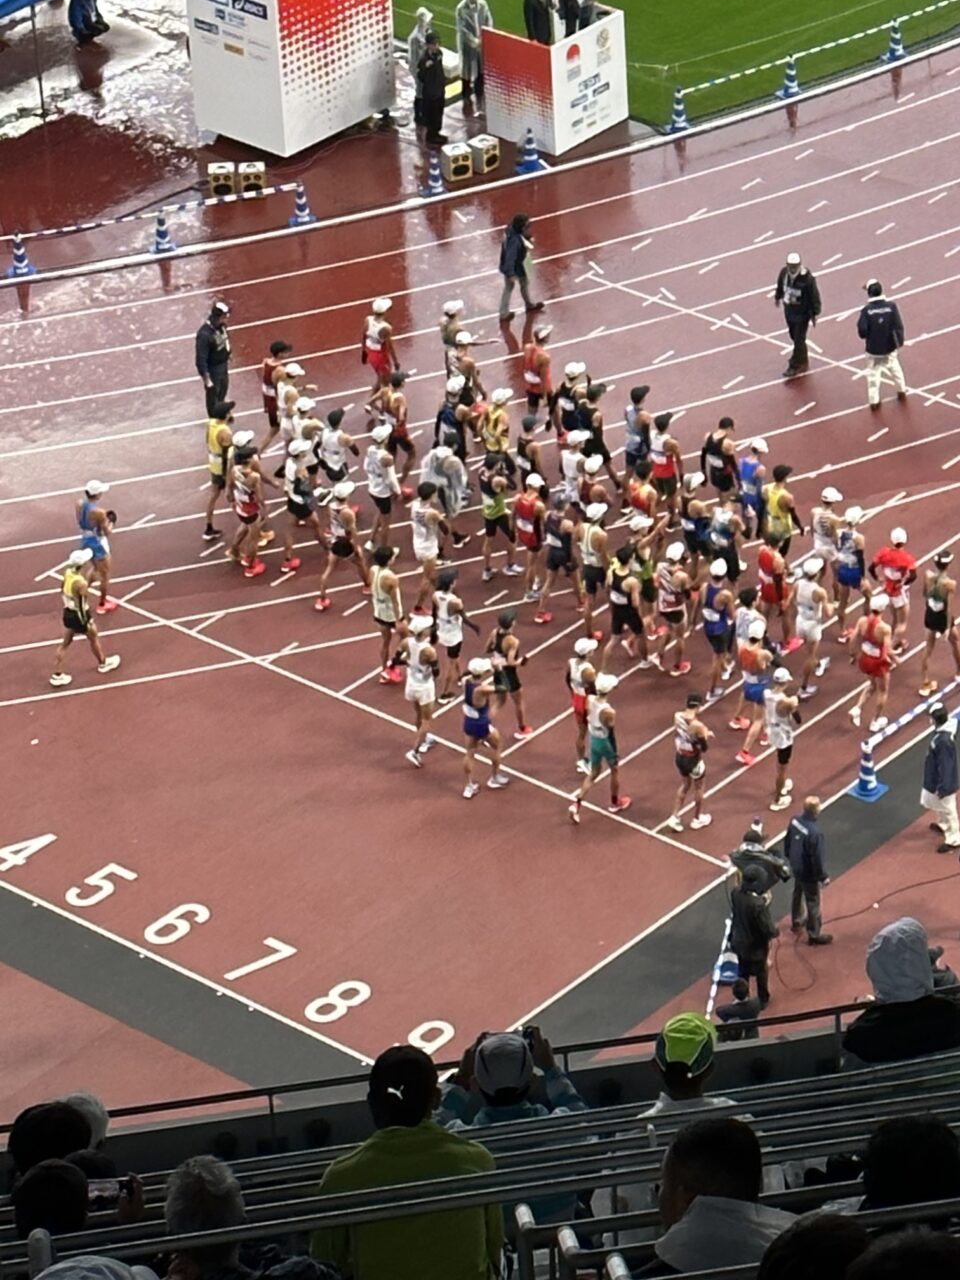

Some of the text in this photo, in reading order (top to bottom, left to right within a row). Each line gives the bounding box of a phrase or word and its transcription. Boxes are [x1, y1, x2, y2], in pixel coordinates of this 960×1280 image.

[0, 833, 58, 872] 4
[65, 862, 138, 908] 5
[143, 902, 211, 945] 6
[223, 937, 298, 981] 7
[304, 980, 372, 1023] 8
